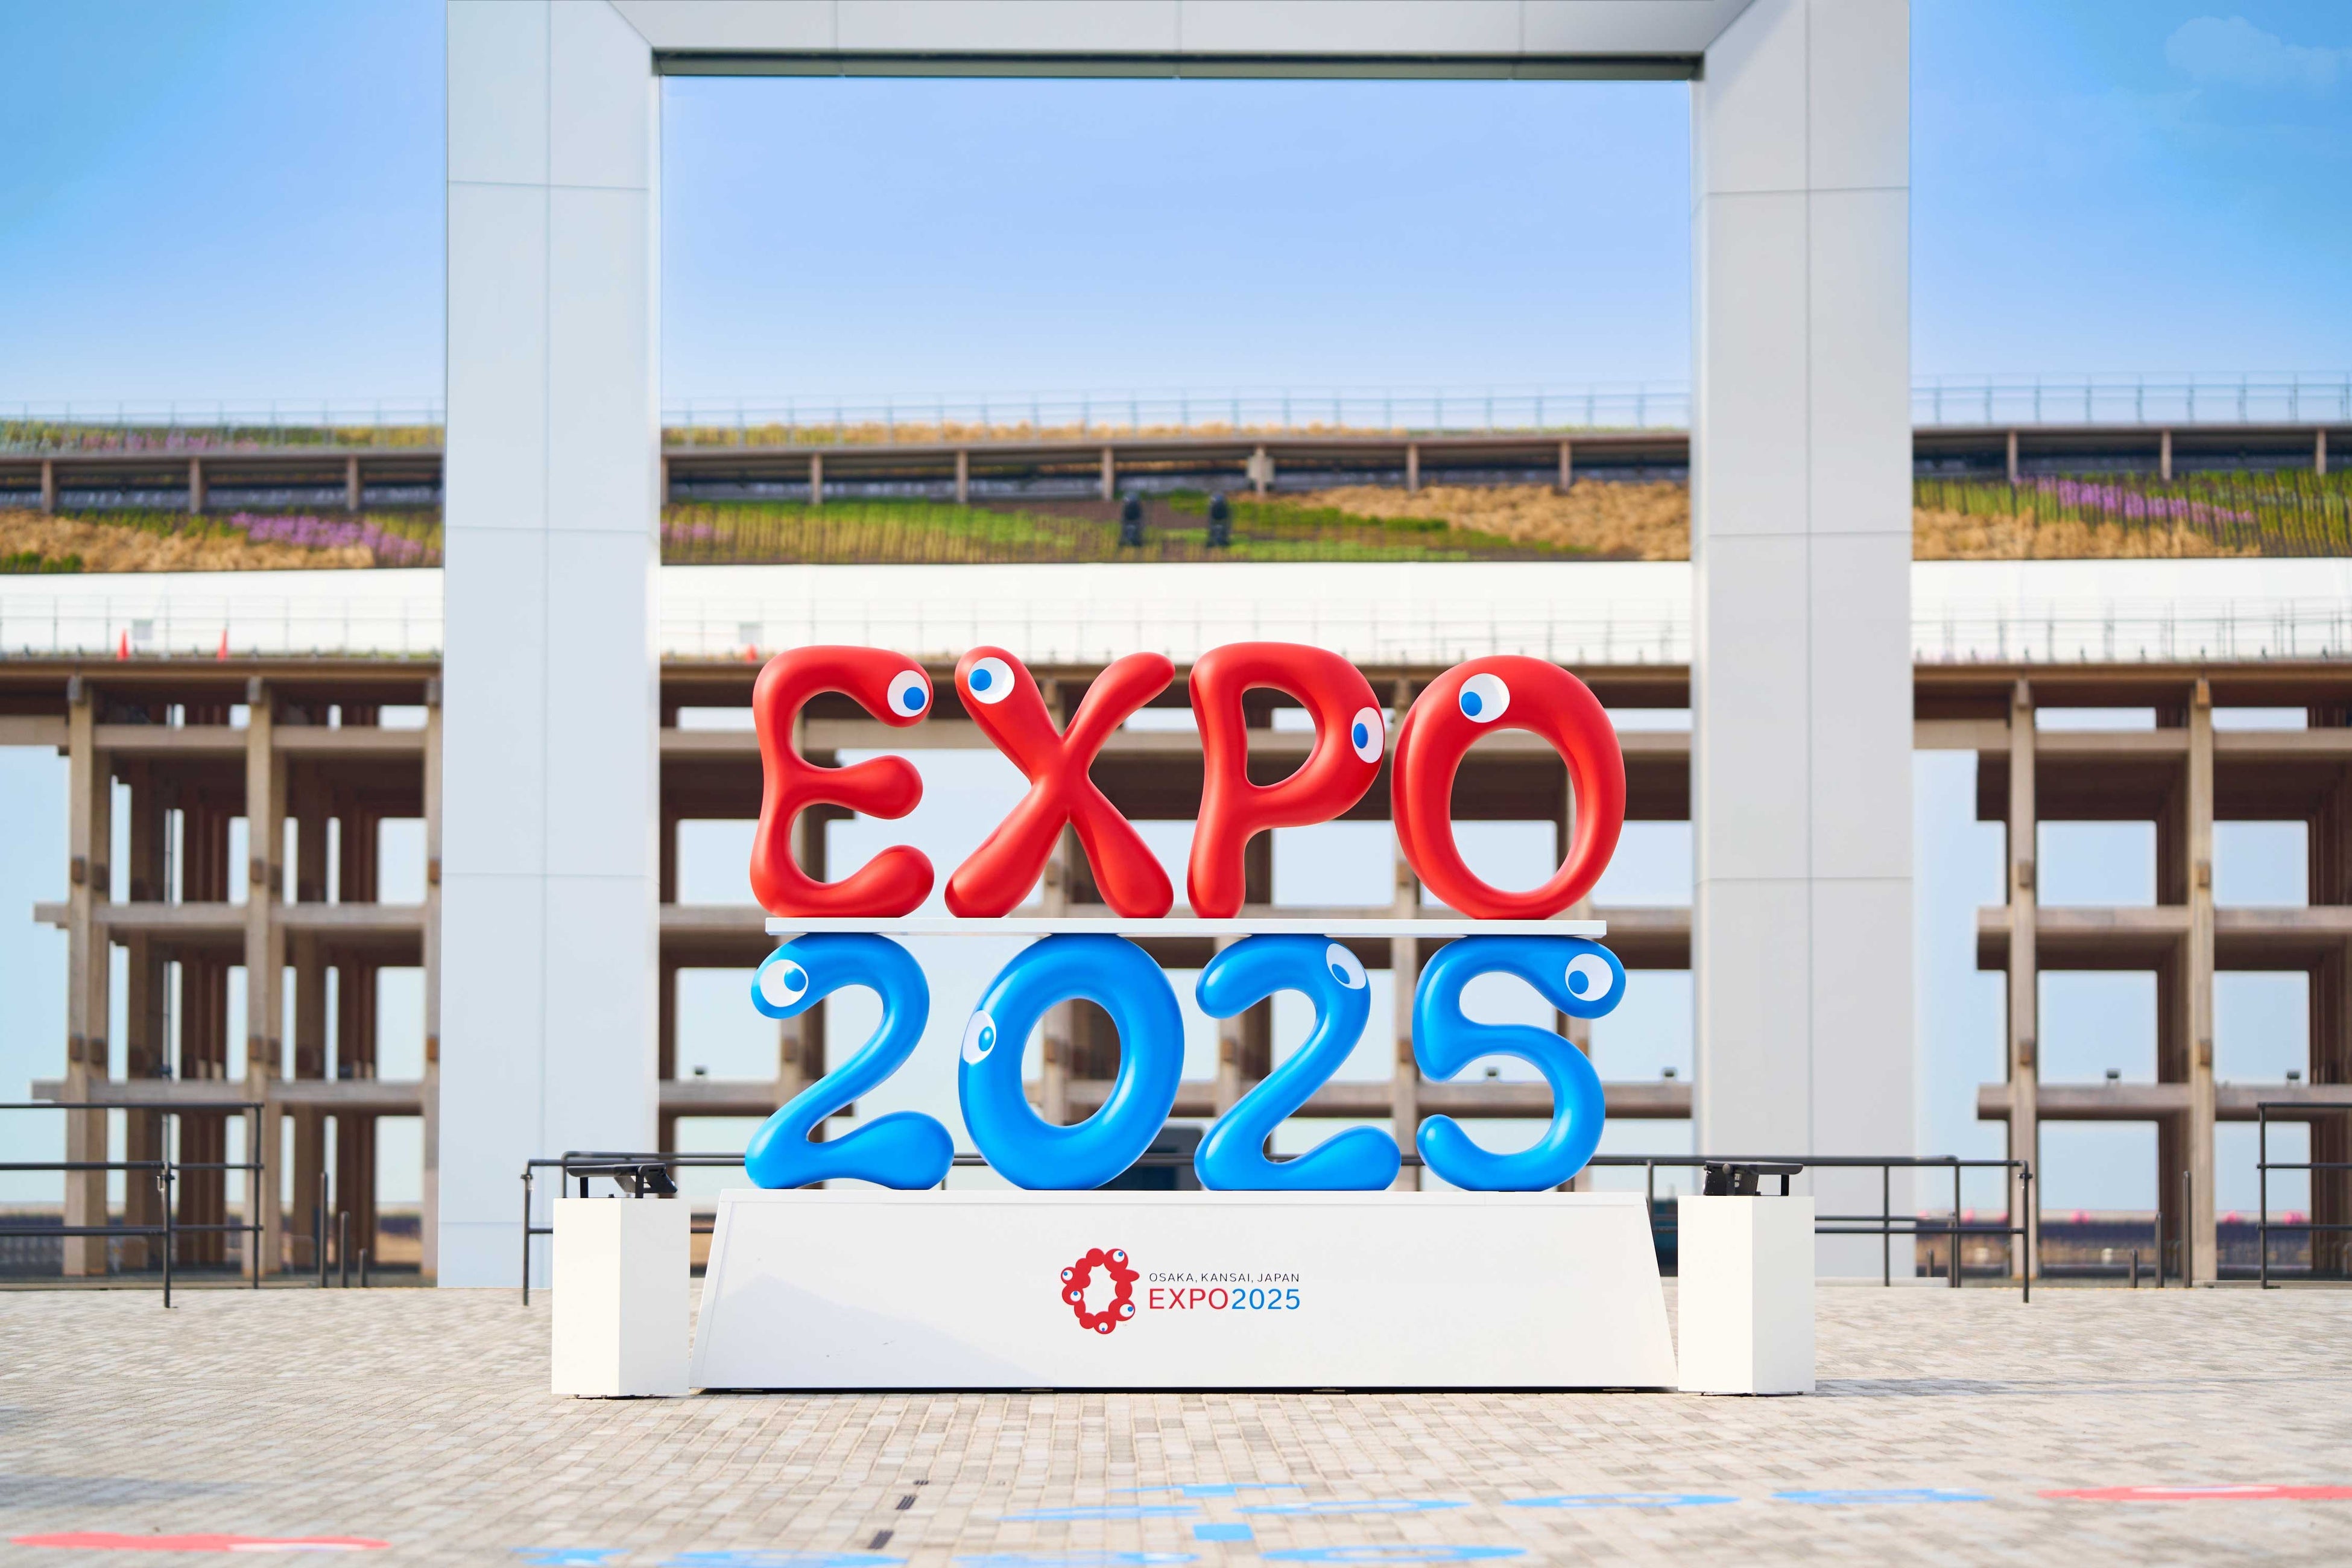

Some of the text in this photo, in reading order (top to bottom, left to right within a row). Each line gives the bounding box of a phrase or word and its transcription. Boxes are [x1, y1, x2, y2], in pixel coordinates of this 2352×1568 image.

[750, 641, 1626, 920] EXPO
[744, 933, 1627, 1190] 2025
[1149, 1272, 1299, 1283] OSAKA, KANSAI, JAPAN
[1149, 1288, 1300, 1310] EXPO2025
